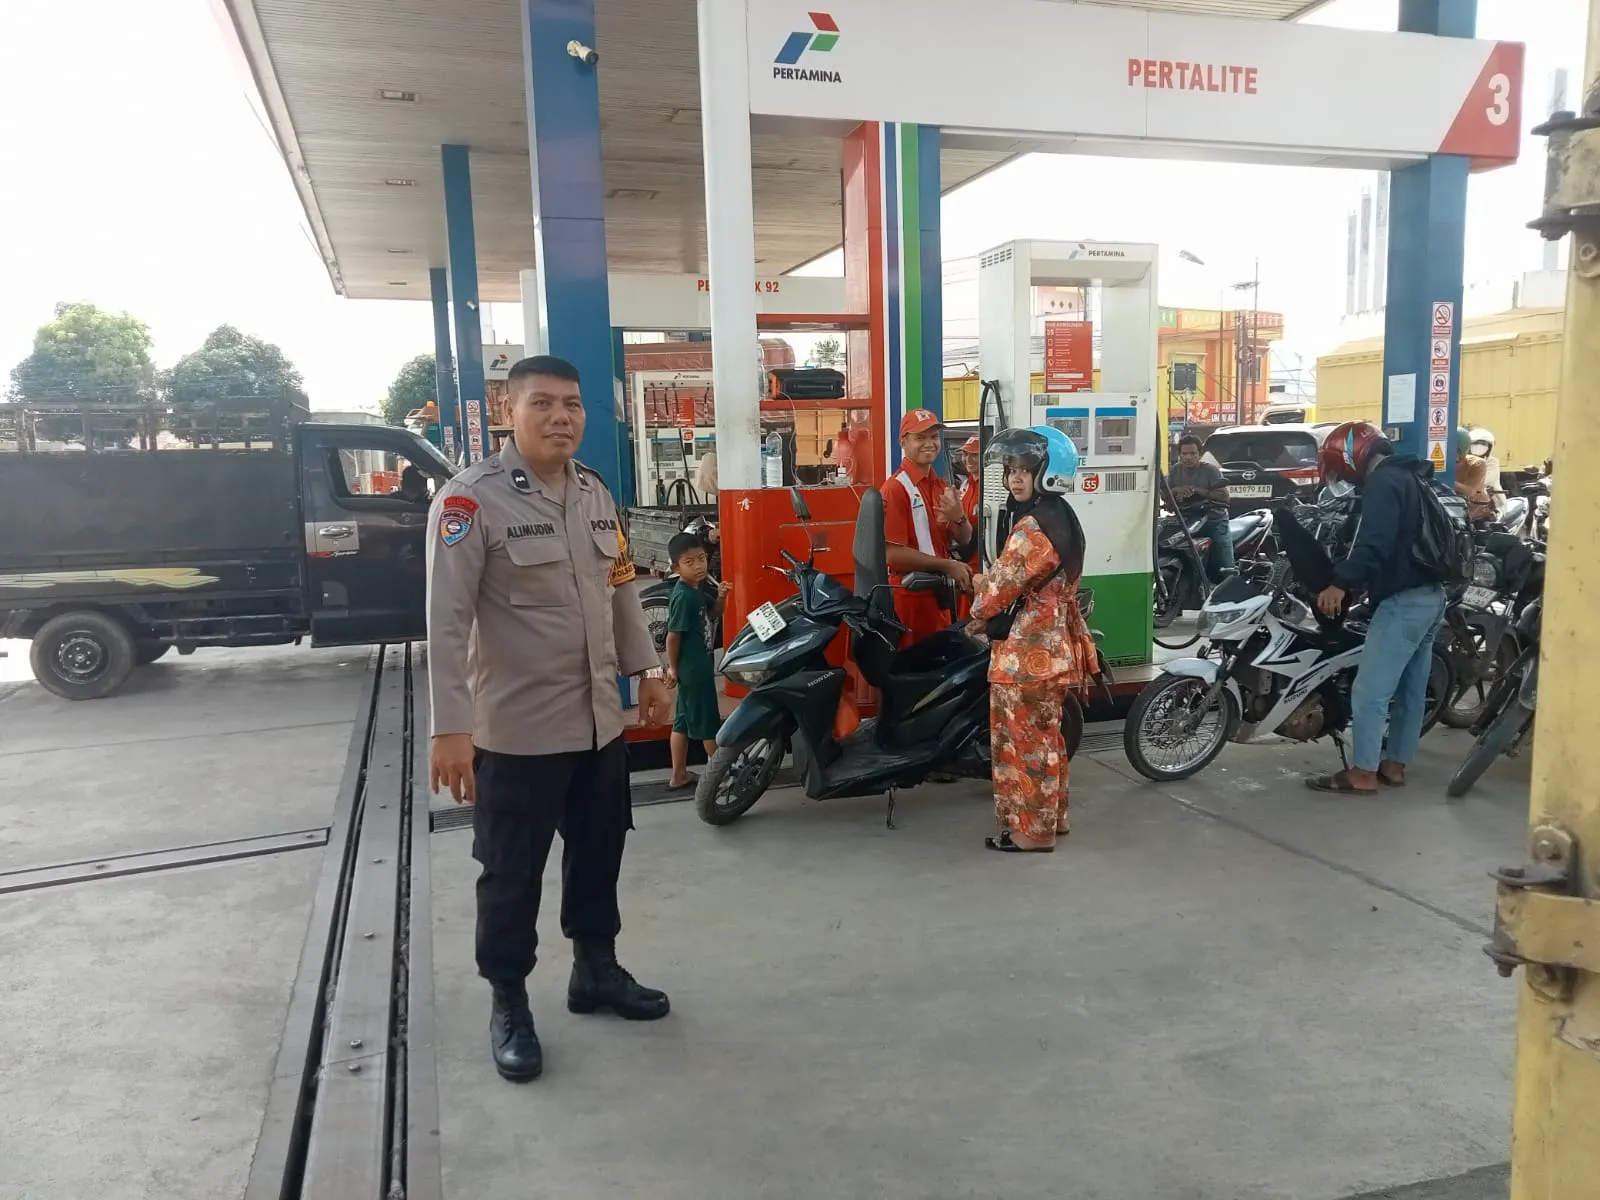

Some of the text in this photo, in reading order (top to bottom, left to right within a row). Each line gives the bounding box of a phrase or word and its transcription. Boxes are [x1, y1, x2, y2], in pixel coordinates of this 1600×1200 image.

[773, 67, 842, 83] PERTAMINA
[1127, 58, 1258, 94] PERTALITE
[1486, 73, 1510, 126] 3
[1088, 249, 1125, 257] PERTAMINA
[765, 281, 780, 293] 92
[507, 522, 555, 539] ALIMUDIN
[807, 671, 835, 688] HONDA
